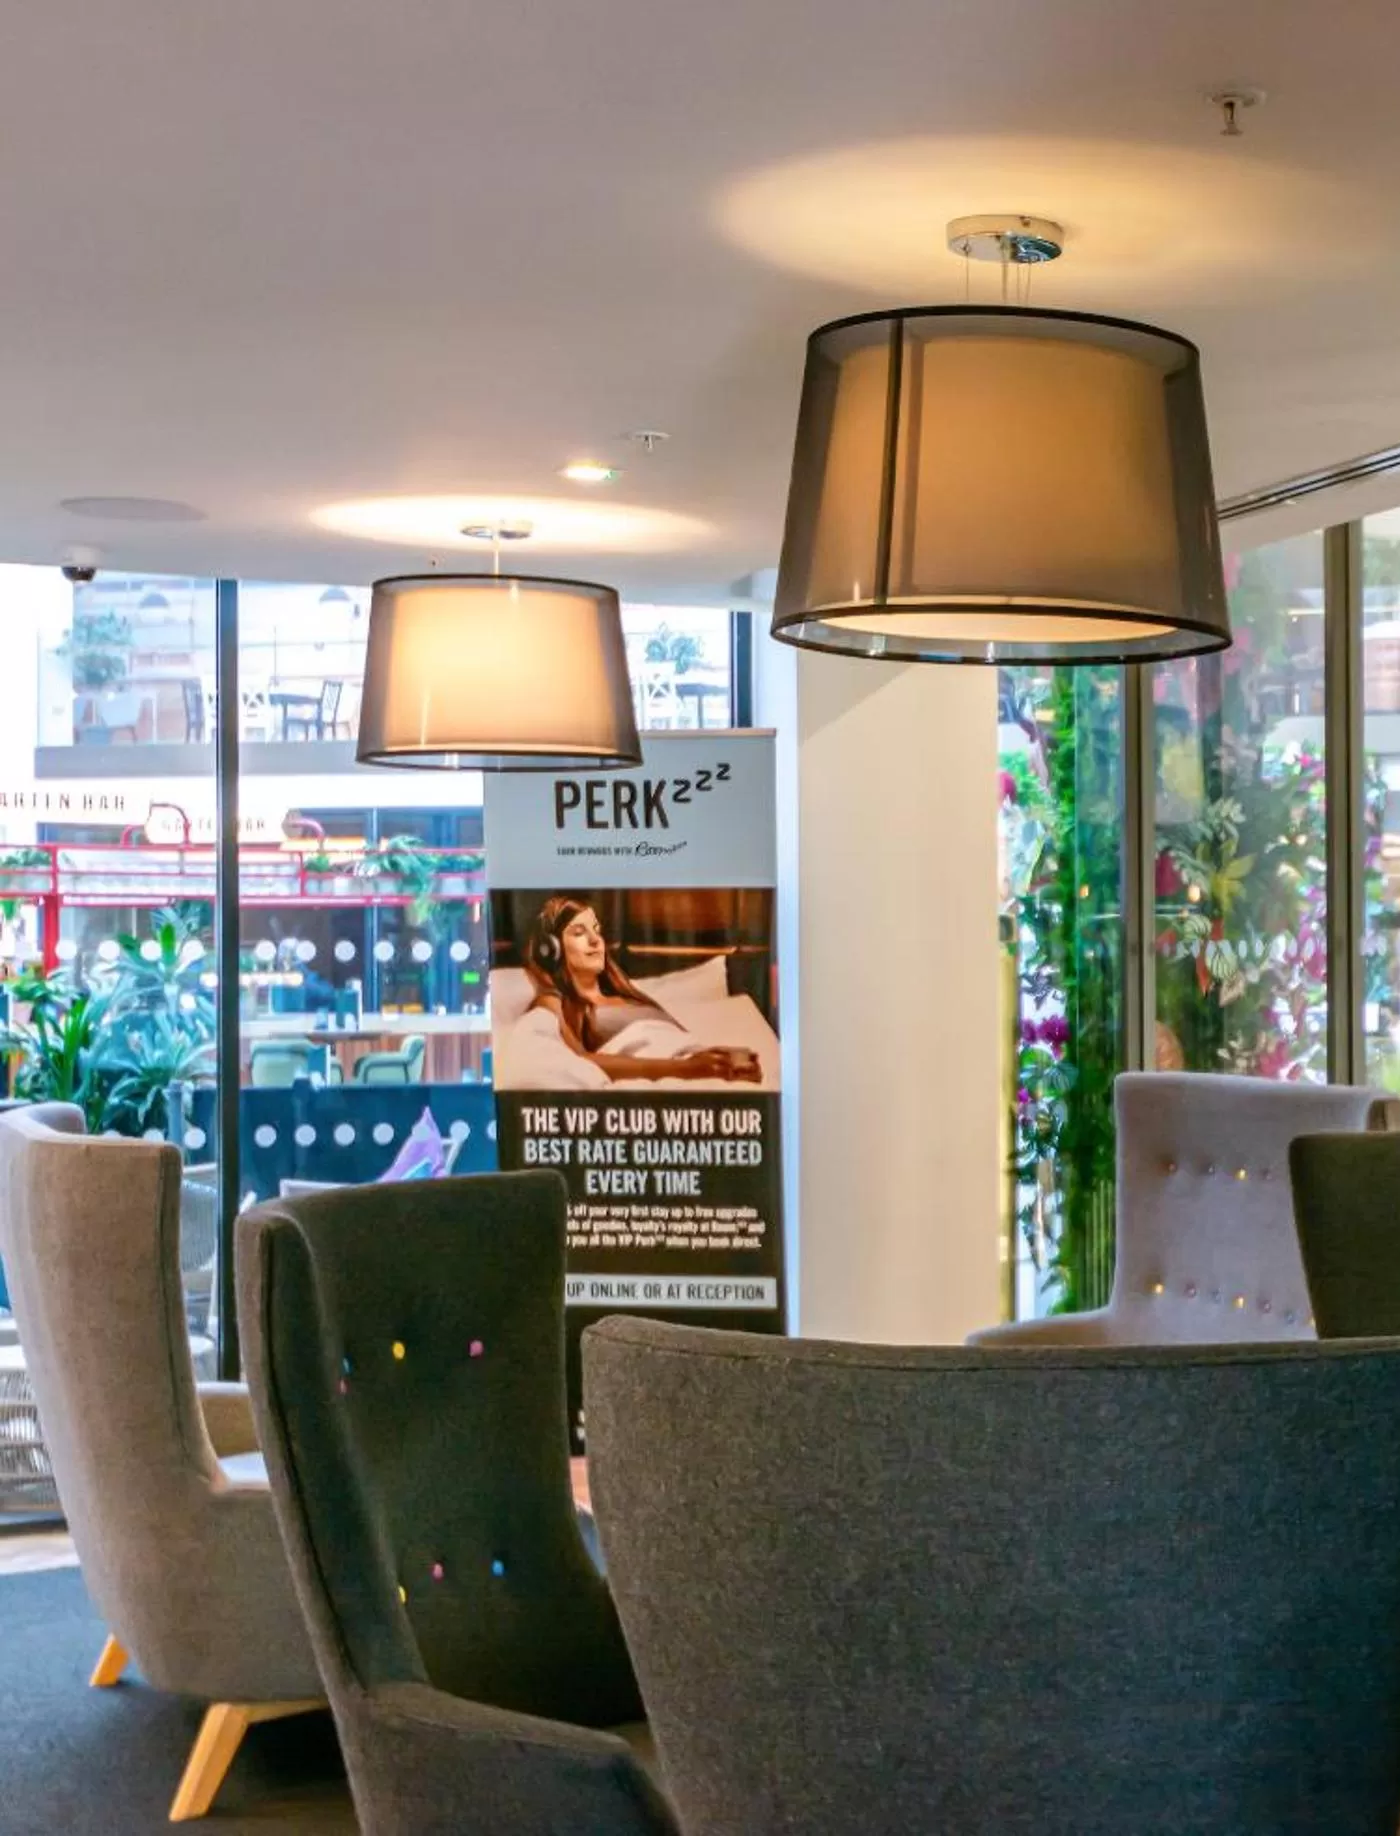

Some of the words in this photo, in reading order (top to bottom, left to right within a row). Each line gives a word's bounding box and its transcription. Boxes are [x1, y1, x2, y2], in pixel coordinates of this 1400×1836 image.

[521, 1107, 560, 1133] THE
[564, 1107, 598, 1134] VIP
[605, 1107, 657, 1134] CLUB
[662, 1108, 714, 1134] WITH
[721, 1109, 762, 1135] OUR
[524, 1138, 572, 1164] BEST
[578, 1139, 627, 1164] RATE
[633, 1139, 762, 1166] GUARANTEED
[586, 1169, 648, 1195] EVERY
[653, 1171, 702, 1195] TIME
[567, 1283, 584, 1297] UP
[591, 1283, 638, 1299] ONLINE
[643, 1283, 661, 1299] OR
[667, 1284, 681, 1299] AT
[688, 1284, 765, 1300] RECEPTION
